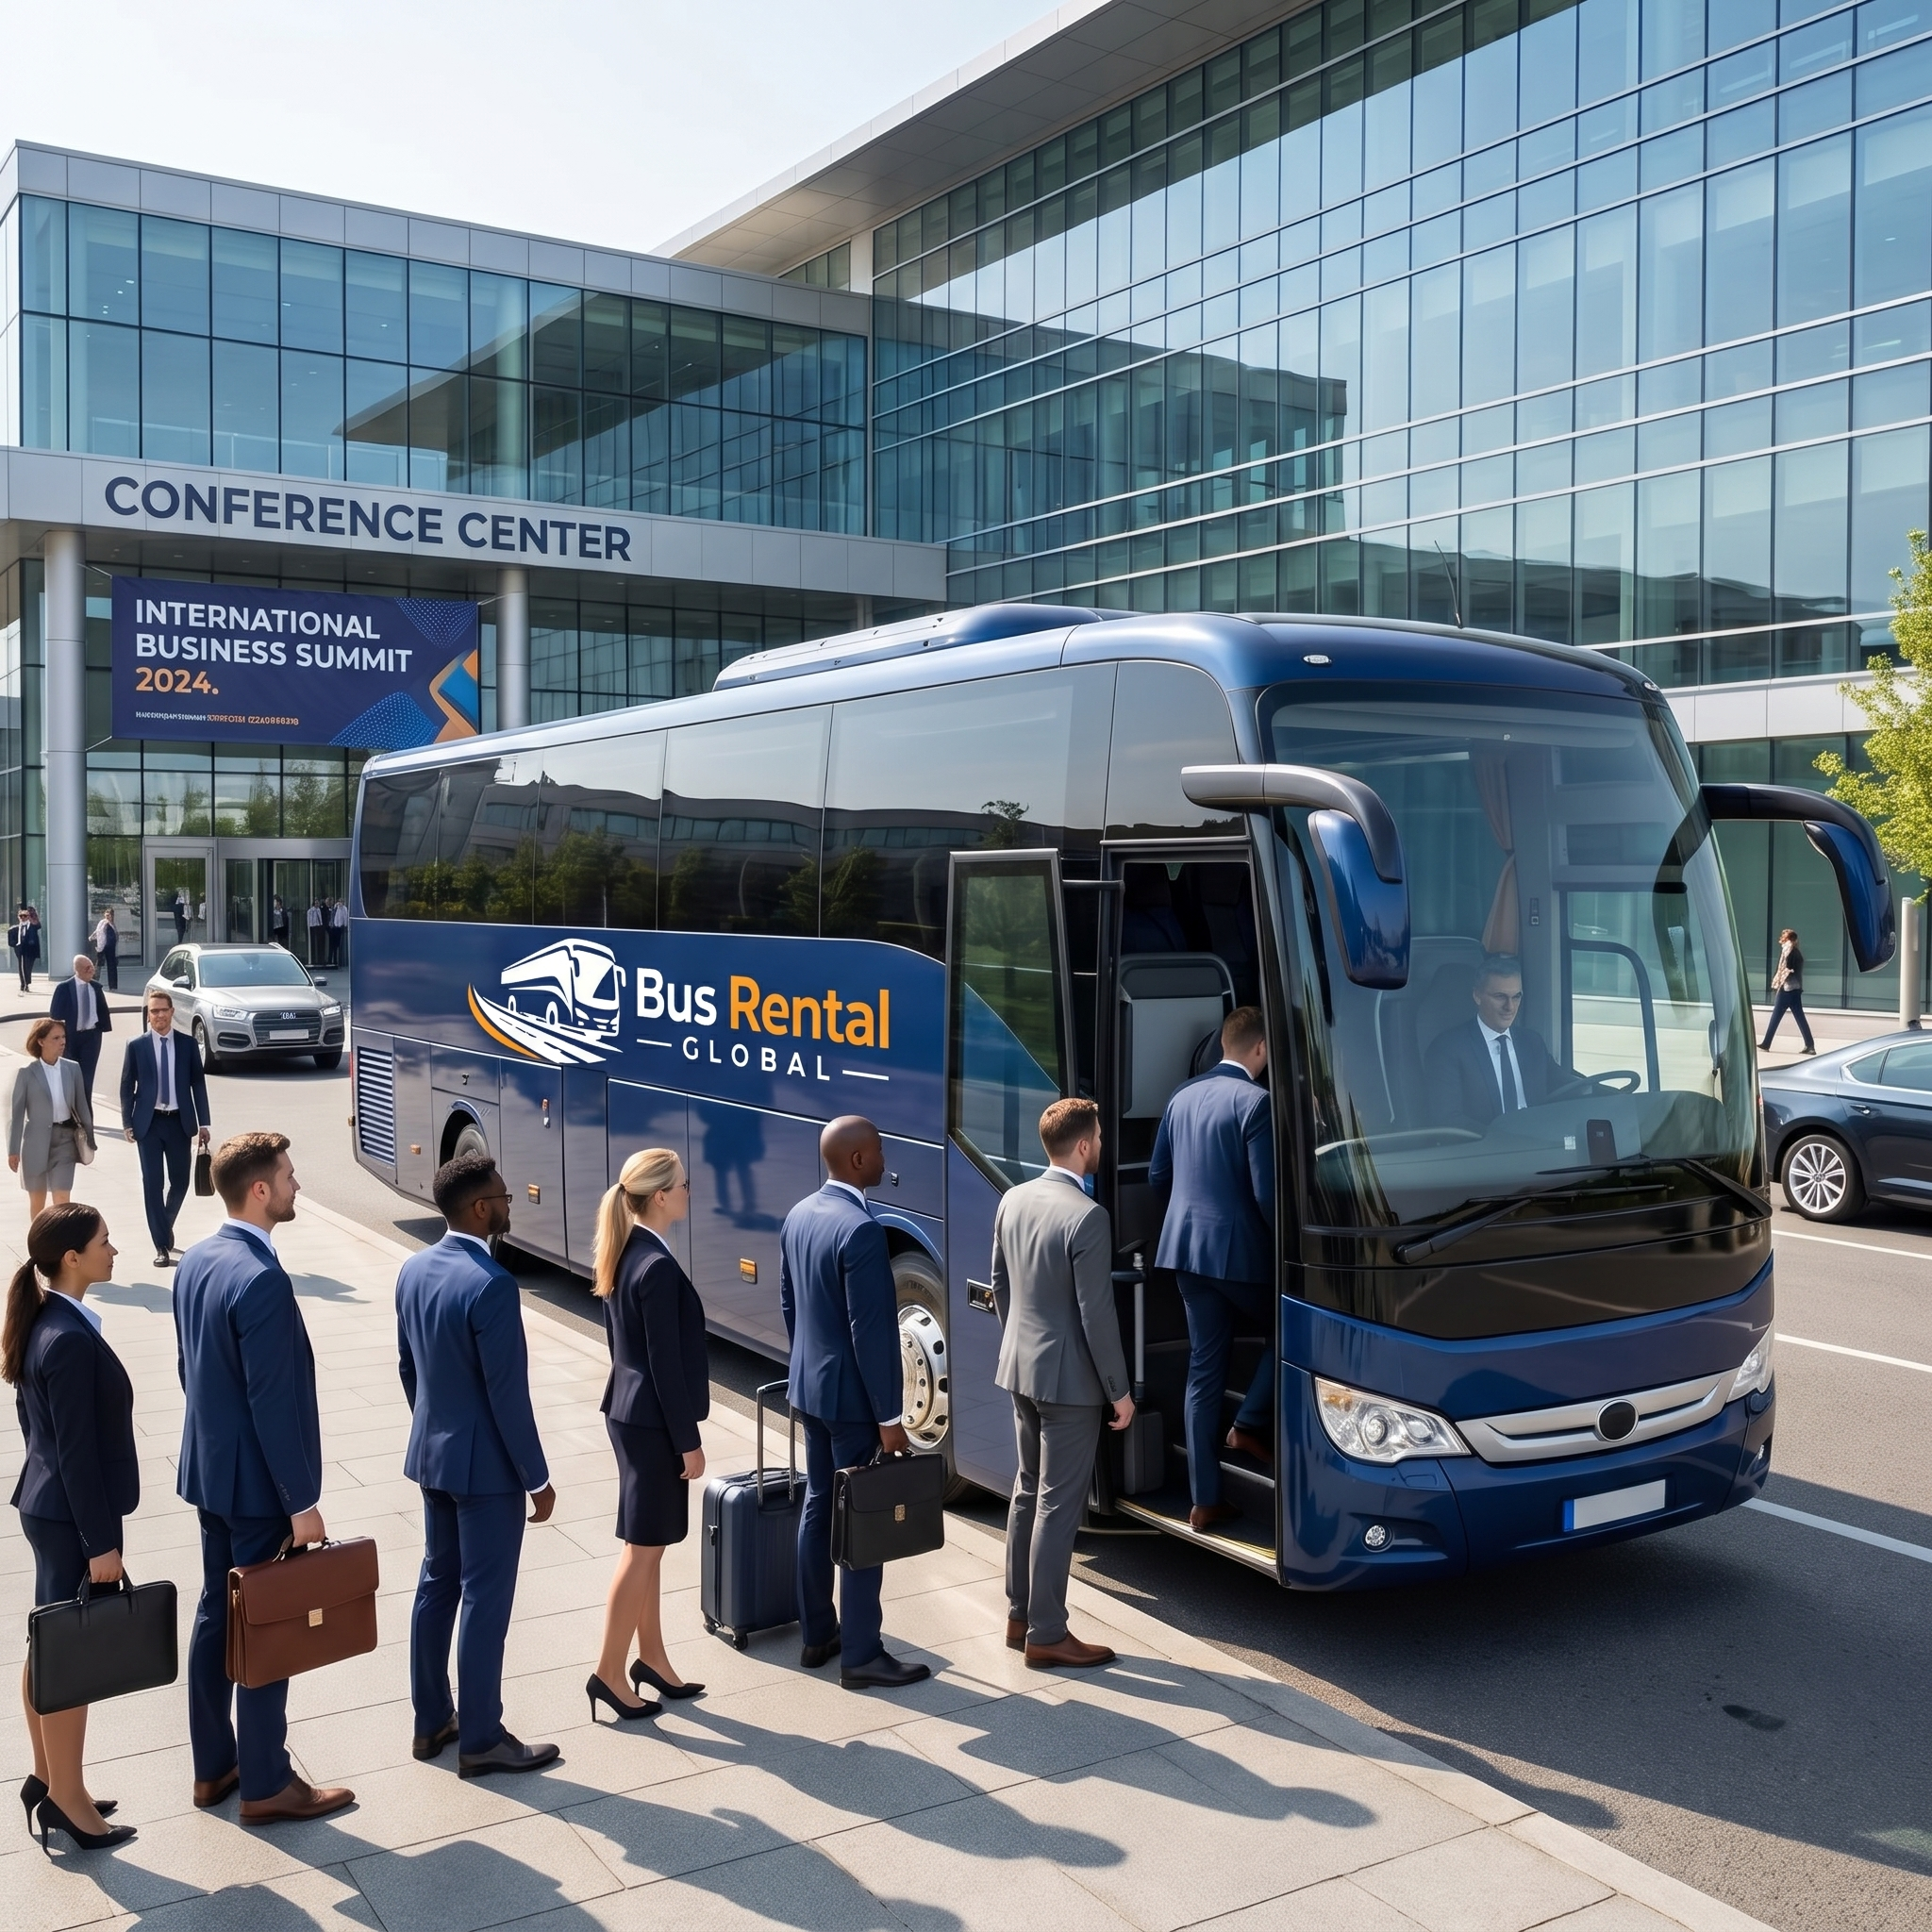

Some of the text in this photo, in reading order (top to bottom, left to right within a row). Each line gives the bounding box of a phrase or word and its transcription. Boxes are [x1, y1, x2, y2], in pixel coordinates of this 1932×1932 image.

[105, 476, 632, 561] CONFERENCE CENTER
[135, 599, 381, 640] INTERNATIONAL
[135, 633, 413, 673] BUSINESS SUMMIT
[135, 667, 219, 695] 2024.
[637, 967, 890, 1049] Bus Rental
[682, 1036, 830, 1081] GLOBAL
